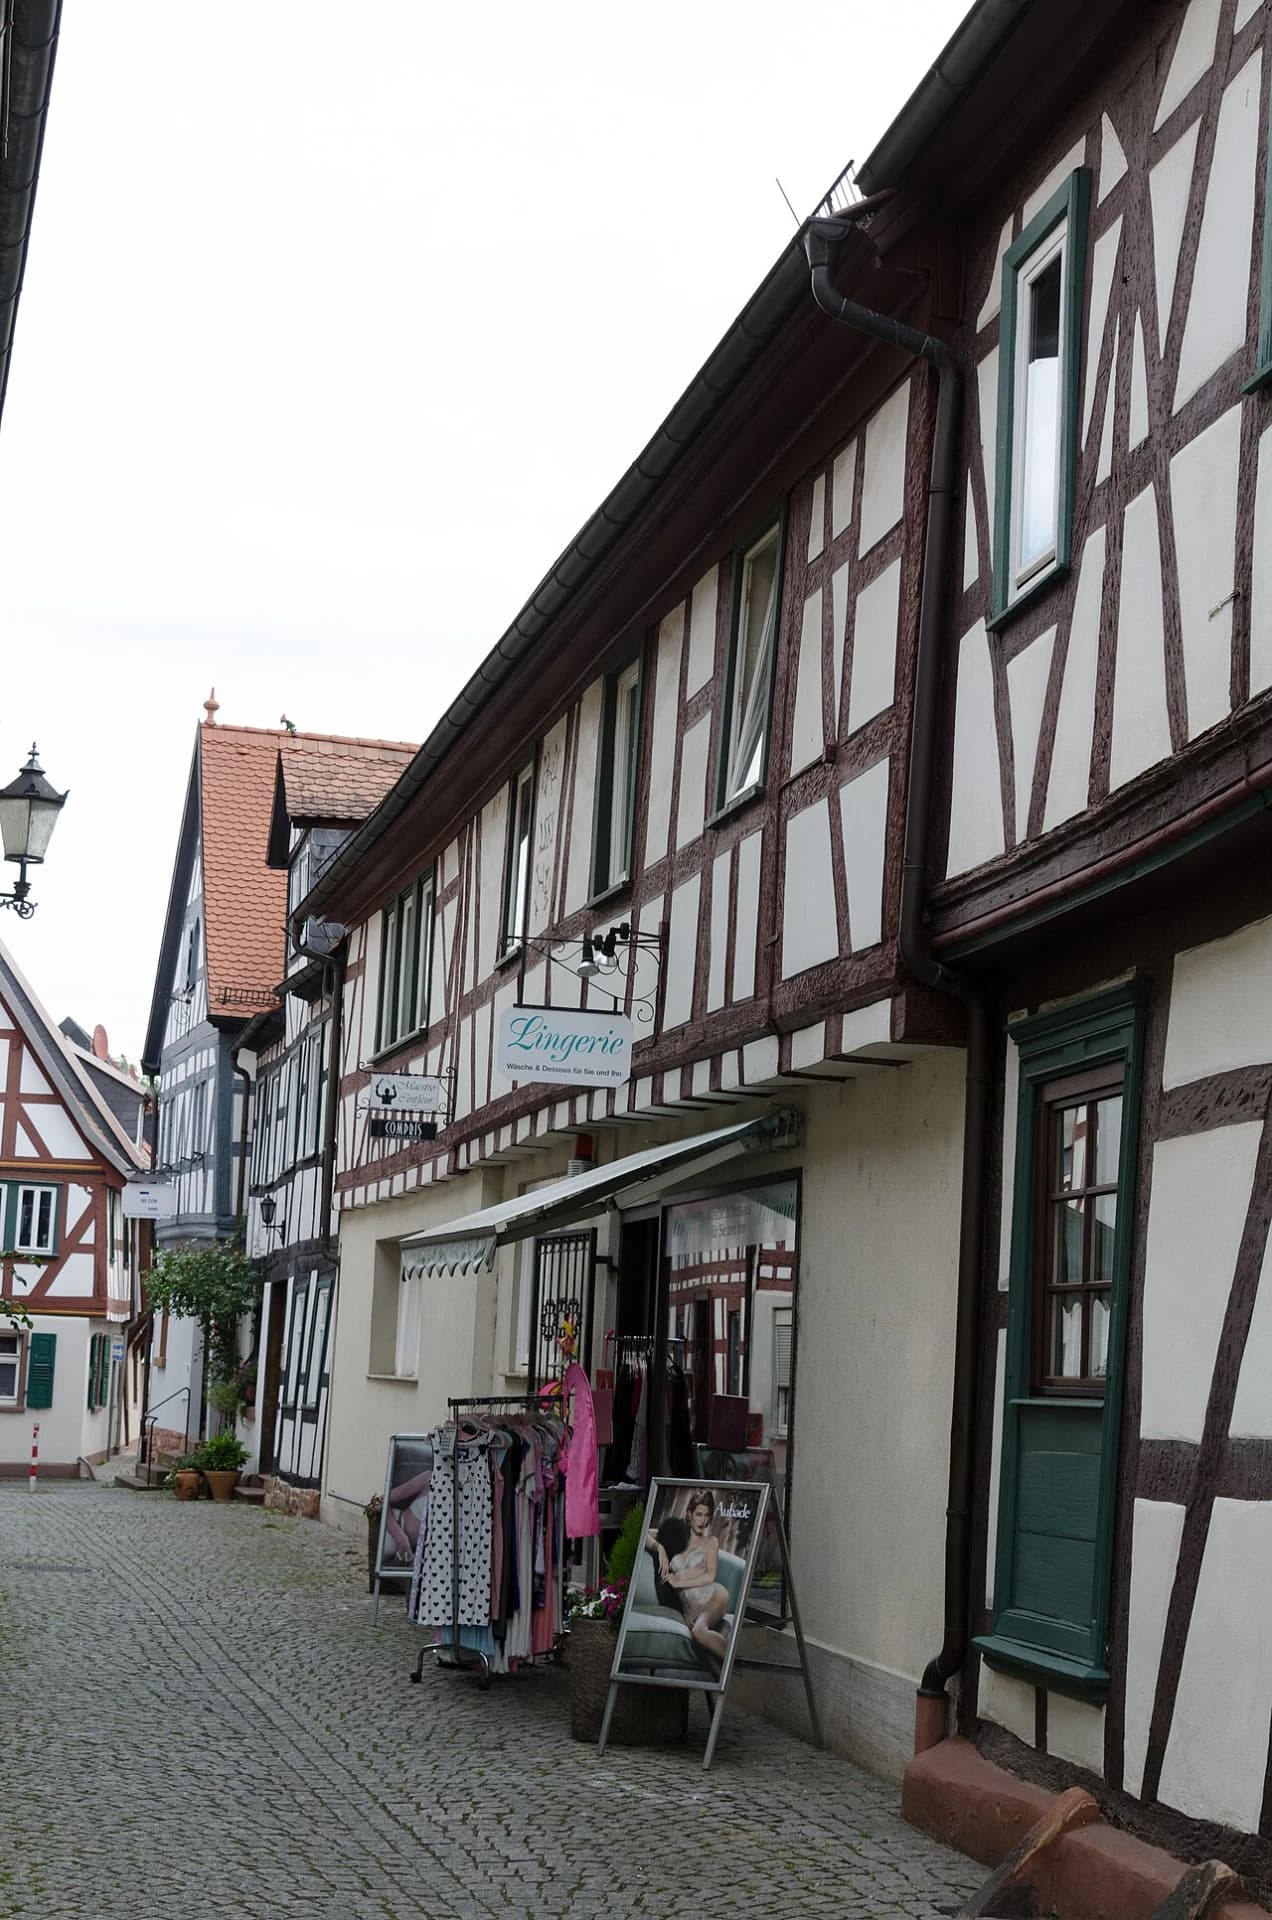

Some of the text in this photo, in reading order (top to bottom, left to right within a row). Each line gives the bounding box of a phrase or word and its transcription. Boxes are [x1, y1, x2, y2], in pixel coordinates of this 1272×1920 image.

[507, 1015, 625, 1062] Lingerie
[506, 1062, 534, 1072] Wäsche
[541, 1064, 572, 1074] Dessous
[572, 1067, 582, 1075] für
[583, 1067, 595, 1076] Sie
[596, 1069, 610, 1077] und
[611, 1069, 623, 1078] Ihn
[384, 1121, 423, 1136] COMPRIS
[713, 1501, 751, 1519] Aubade
